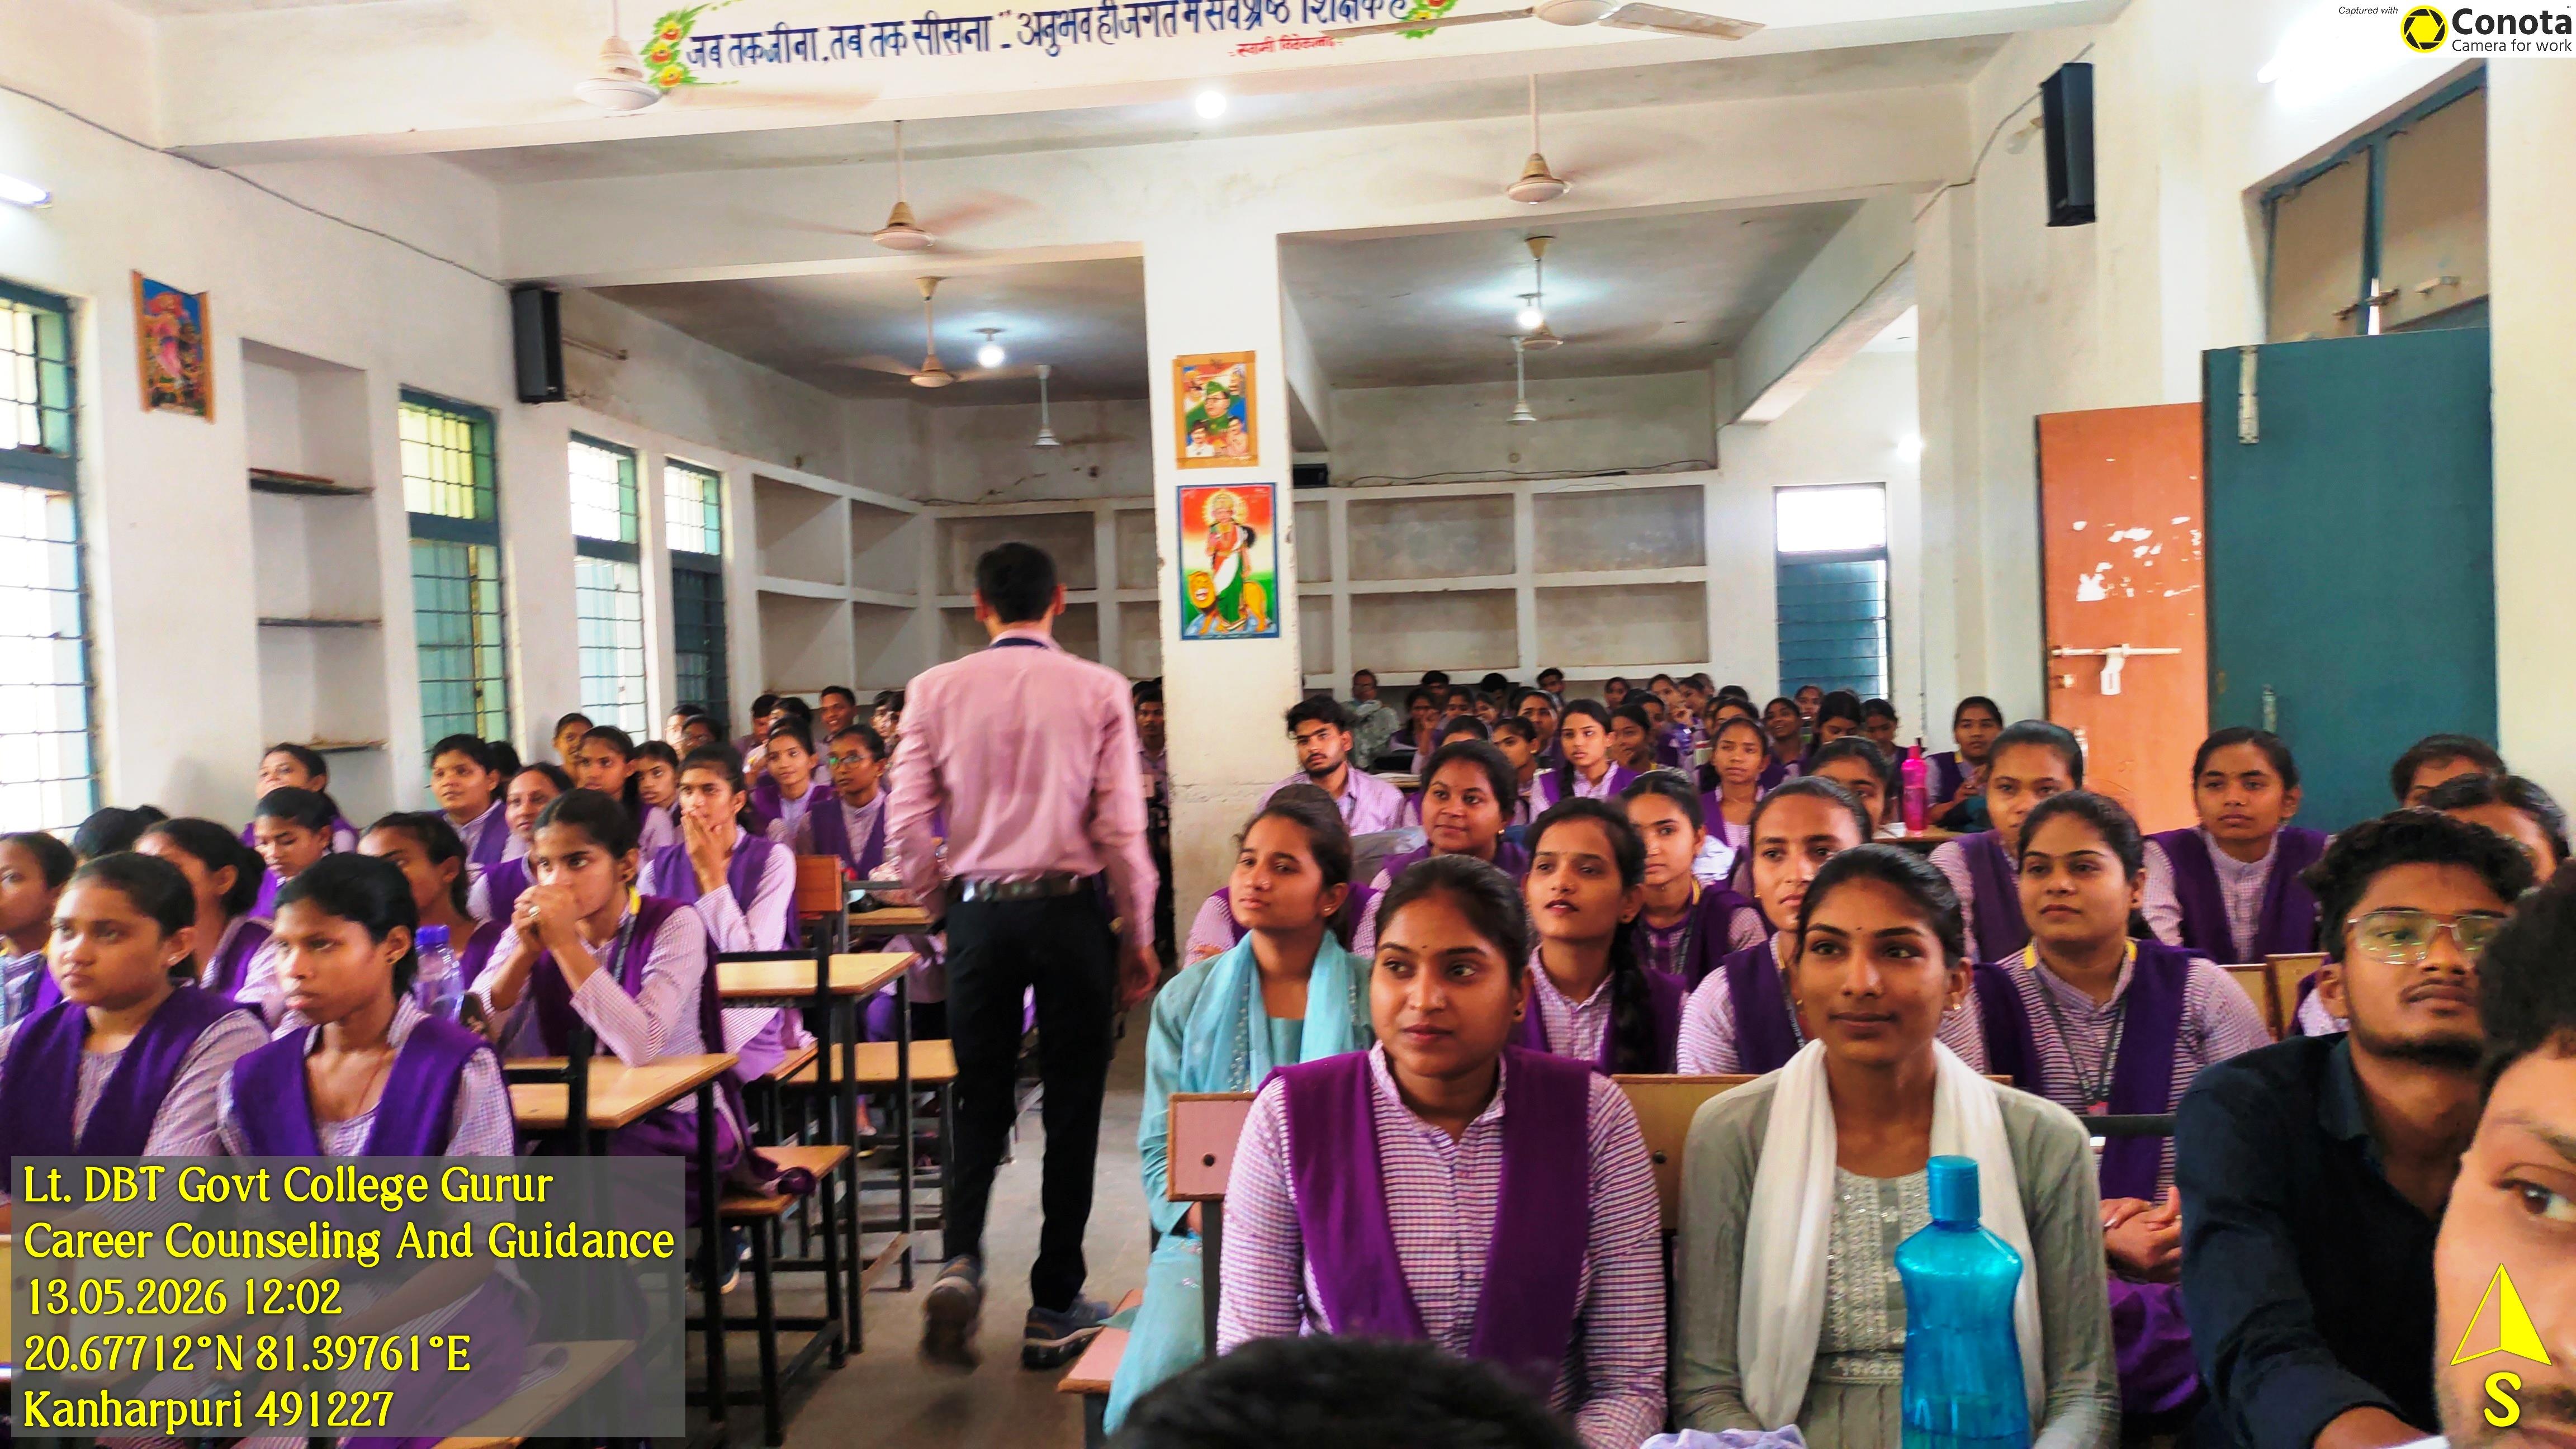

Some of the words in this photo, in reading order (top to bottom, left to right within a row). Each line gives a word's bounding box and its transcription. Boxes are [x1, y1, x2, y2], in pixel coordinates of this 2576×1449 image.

[686, 34, 725, 68] जब
[728, 32, 764, 66] तक
[828, 24, 866, 60] तब
[869, 21, 907, 57] तक
